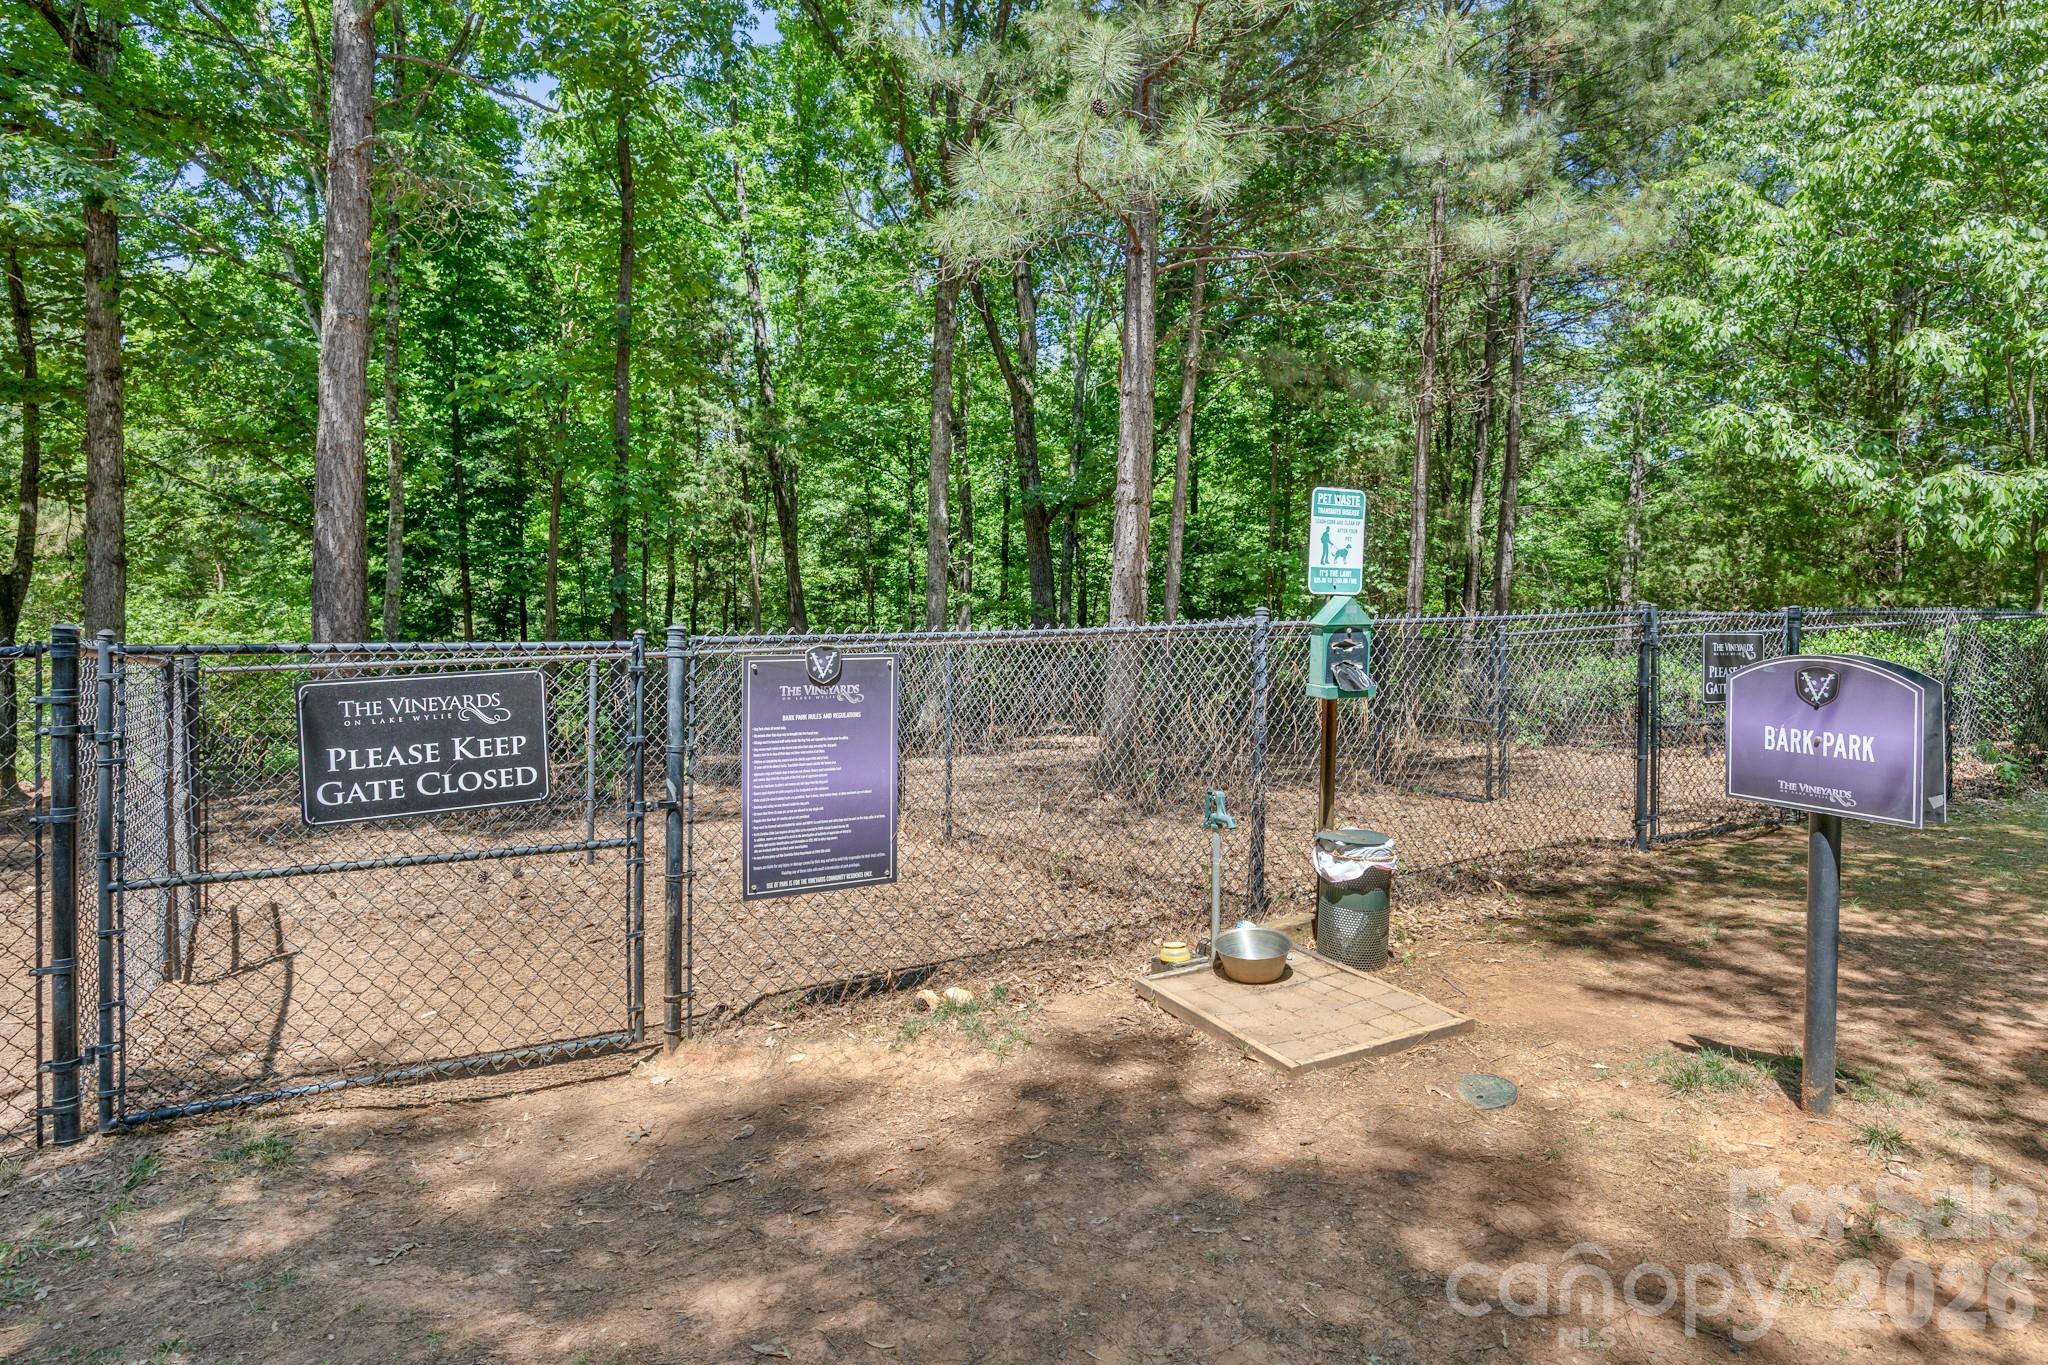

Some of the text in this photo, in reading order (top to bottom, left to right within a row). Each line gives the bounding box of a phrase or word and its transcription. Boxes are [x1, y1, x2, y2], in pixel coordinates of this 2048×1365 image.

[1317, 493, 1361, 506] PET WASTE
[1713, 642, 1725, 652] THE
[1724, 642, 1755, 656] VINEYARDS
[779, 684, 862, 700] THE VINEYARDS
[338, 693, 506, 720] THE VINEYARDS
[823, 712, 832, 720] AND
[833, 711, 862, 719] REGULATIONS
[371, 717, 403, 725] LAKE
[413, 713, 452, 721] WYLIE
[326, 735, 527, 773] PLEASE KEEP
[1764, 726, 1875, 762] BARK PARK
[316, 766, 538, 806] GATE CLOSED
[1777, 779, 1854, 803] THE VINEYARDS
